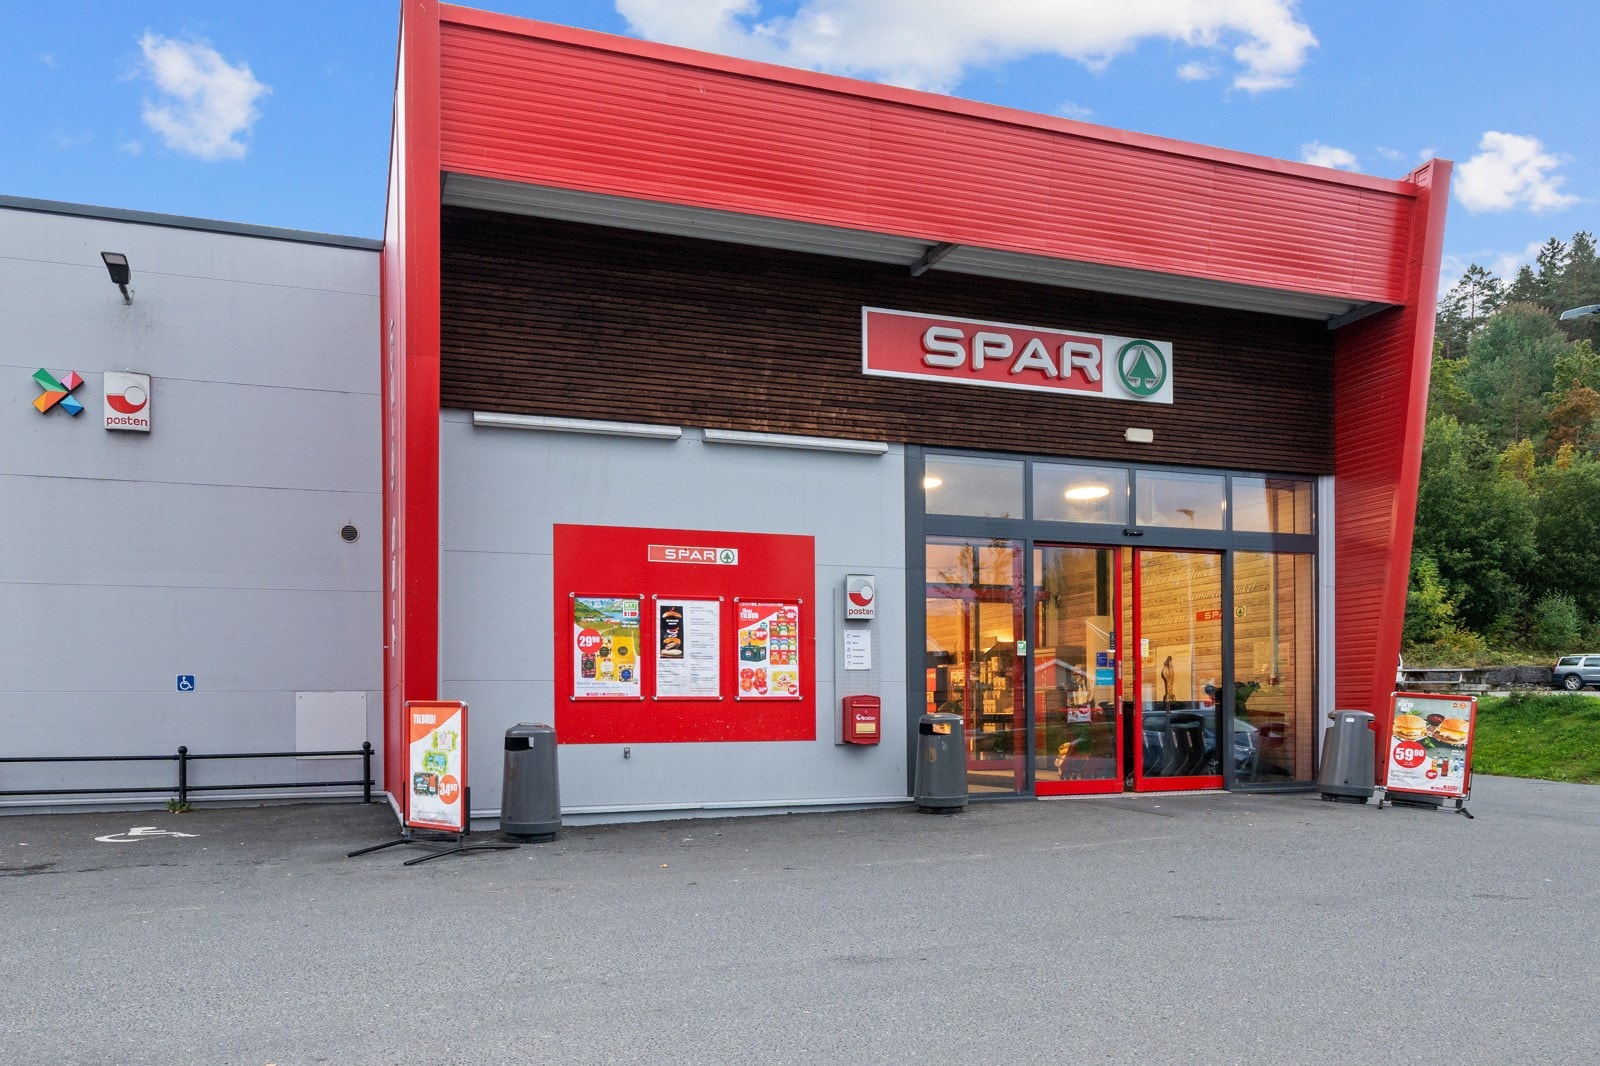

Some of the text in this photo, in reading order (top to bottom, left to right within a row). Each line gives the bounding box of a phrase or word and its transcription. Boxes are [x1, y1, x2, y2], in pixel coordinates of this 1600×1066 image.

[923, 326, 1101, 382] SPAR
[106, 416, 148, 426] posten
[665, 549, 715, 560] SPAR
[848, 607, 873, 616] posten
[413, 714, 436, 724] TILBUD!
